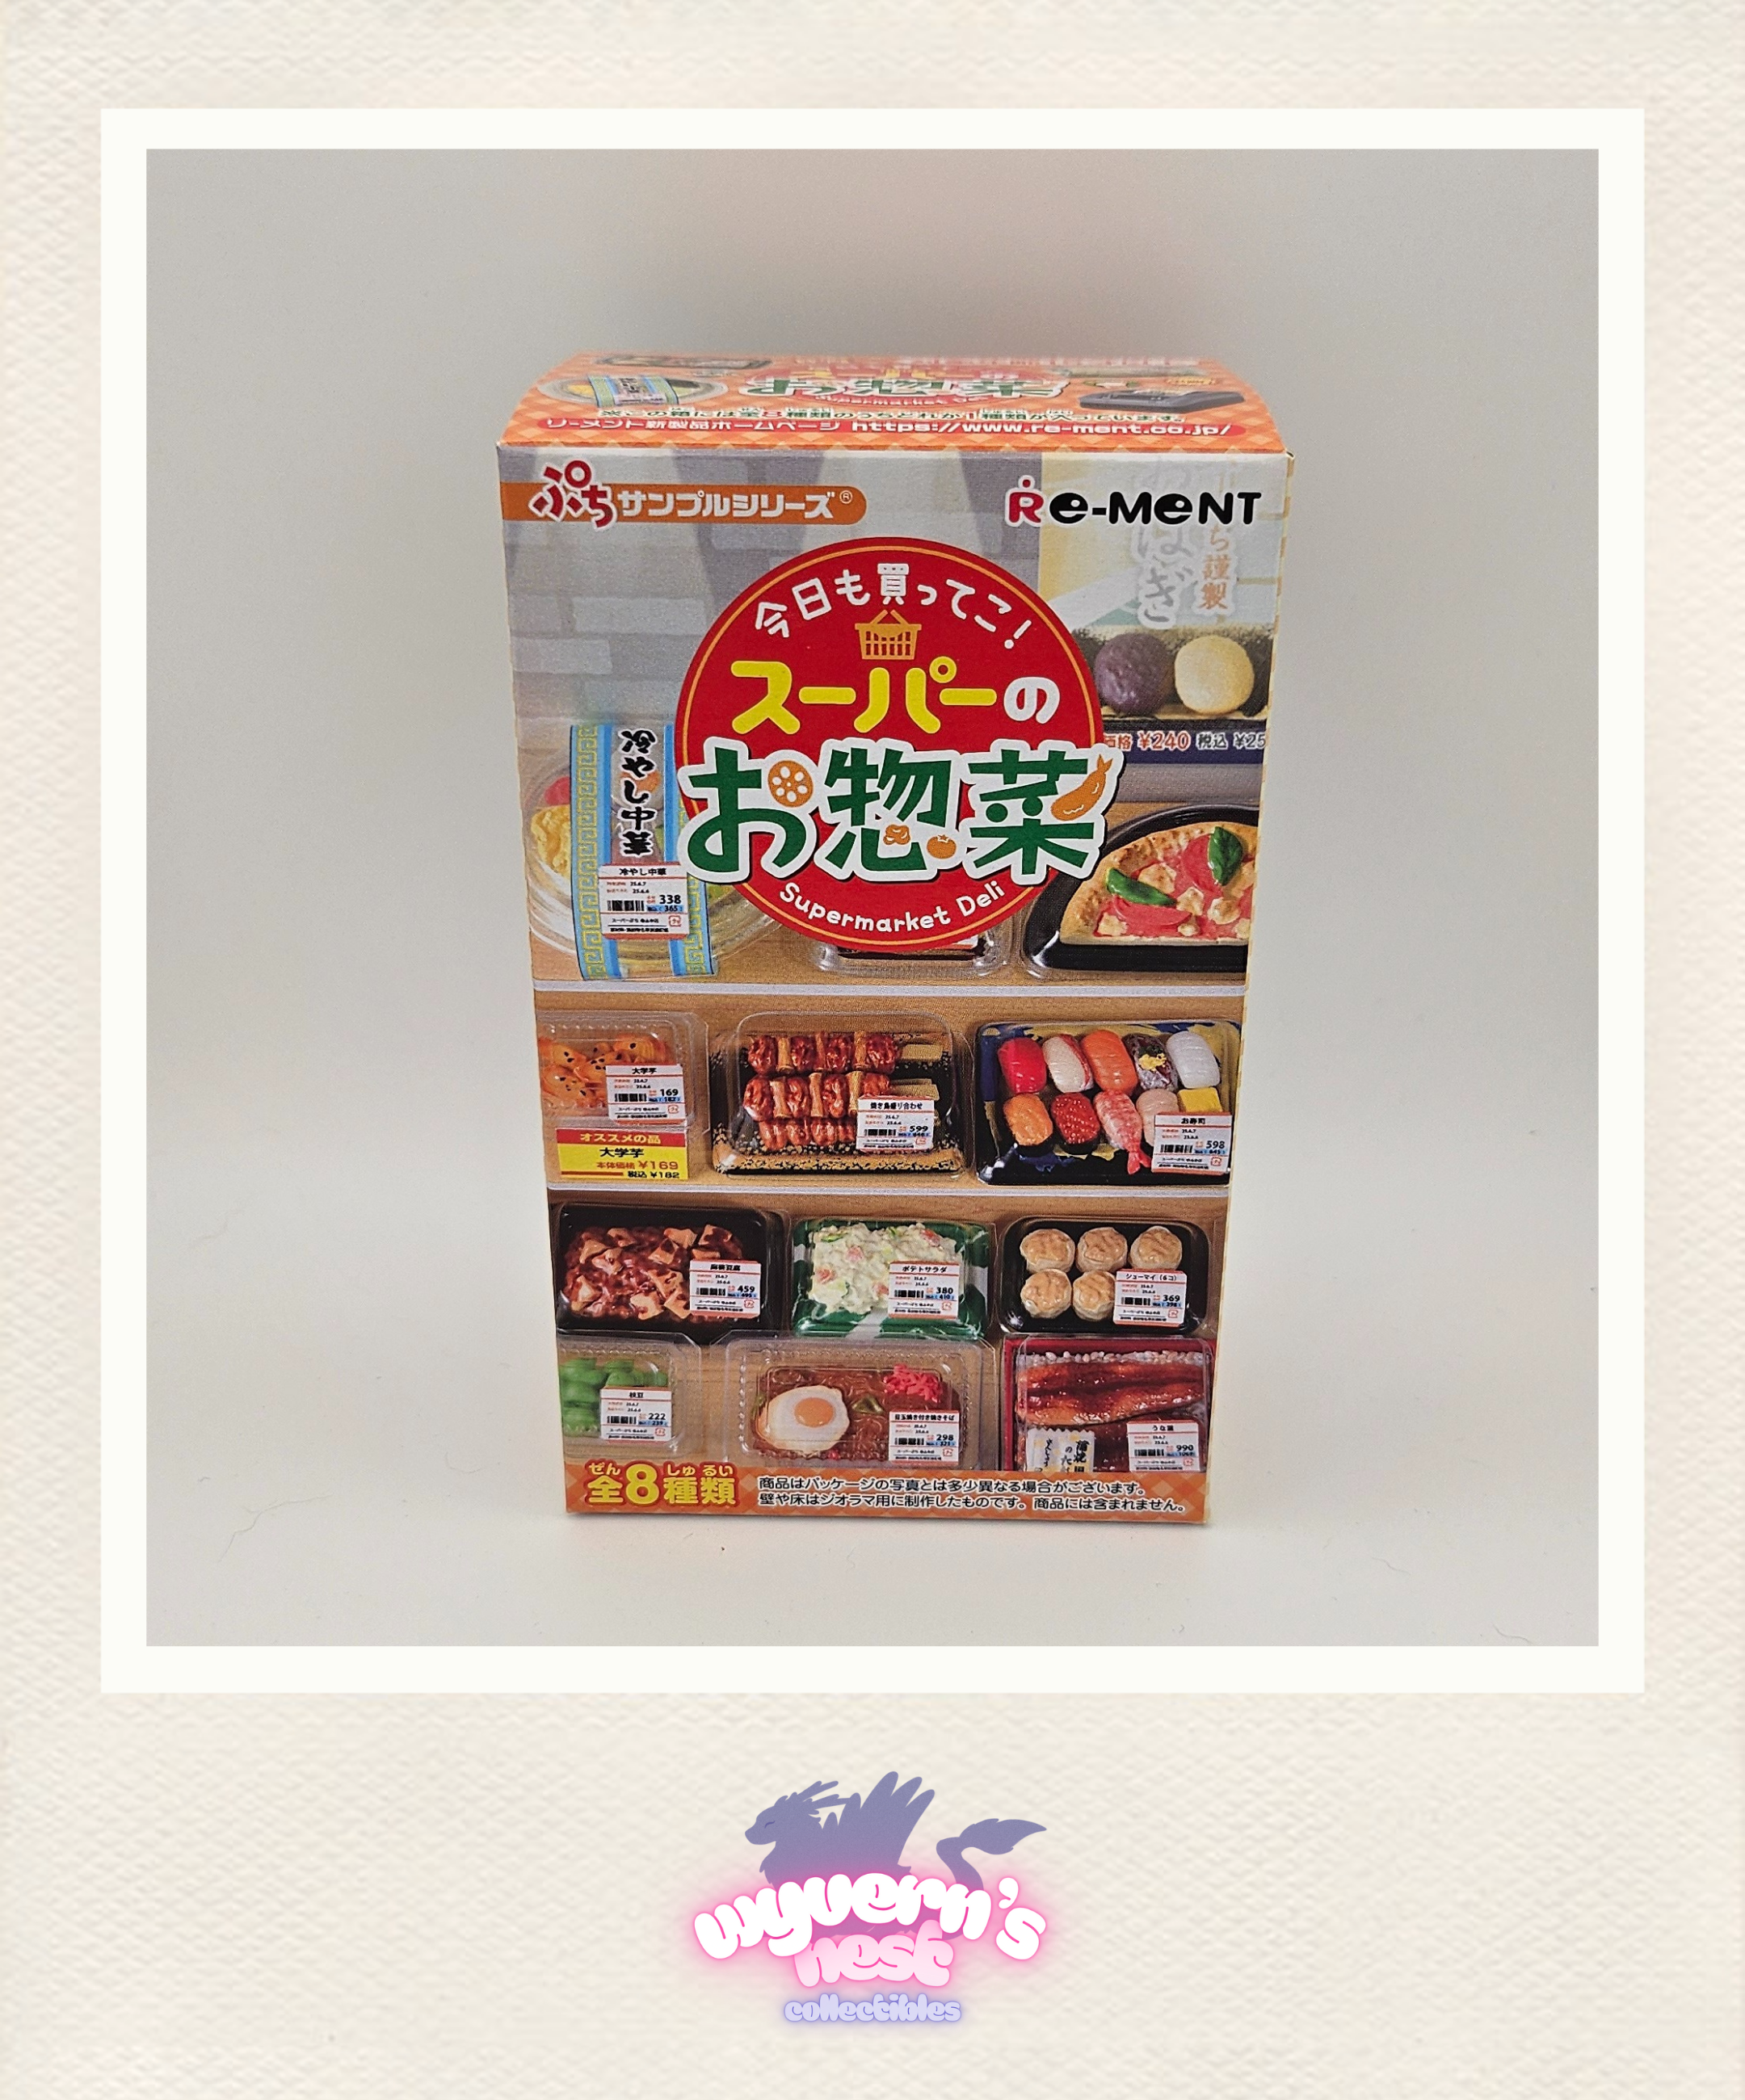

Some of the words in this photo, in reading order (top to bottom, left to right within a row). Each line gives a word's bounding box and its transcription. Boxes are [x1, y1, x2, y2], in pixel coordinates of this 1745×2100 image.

[546, 418, 841, 432] リーメント新製品ホームページ
[851, 420, 1231, 437] https://www.re-ment.co.jp/
[730, 656, 1061, 734] スーパーの
[1137, 732, 1191, 750] ¥240
[683, 745, 1108, 879] お惣菜
[659, 894, 682, 904] 338
[780, 882, 951, 933] Supermarket
[958, 880, 1006, 918] Deli
[659, 1088, 679, 1097] 169
[580, 1132, 662, 1145] オススメの品
[1205, 1140, 1226, 1149] 598
[599, 1147, 645, 1158] 大学芋
[638, 1160, 679, 1170] ¥169
[627, 1170, 648, 1179] 税込
[650, 1171, 680, 1179] ¥182
[737, 1285, 755, 1293] 459
[936, 1287, 954, 1295] 380
[1163, 1294, 1181, 1302] 369
[648, 1413, 666, 1421] 222
[588, 1461, 622, 1476] ぜん
[587, 1463, 737, 1506] 全8種類
[759, 1476, 1146, 1495] 商品はパッケージの写真とは多少異なる場合がございます。
